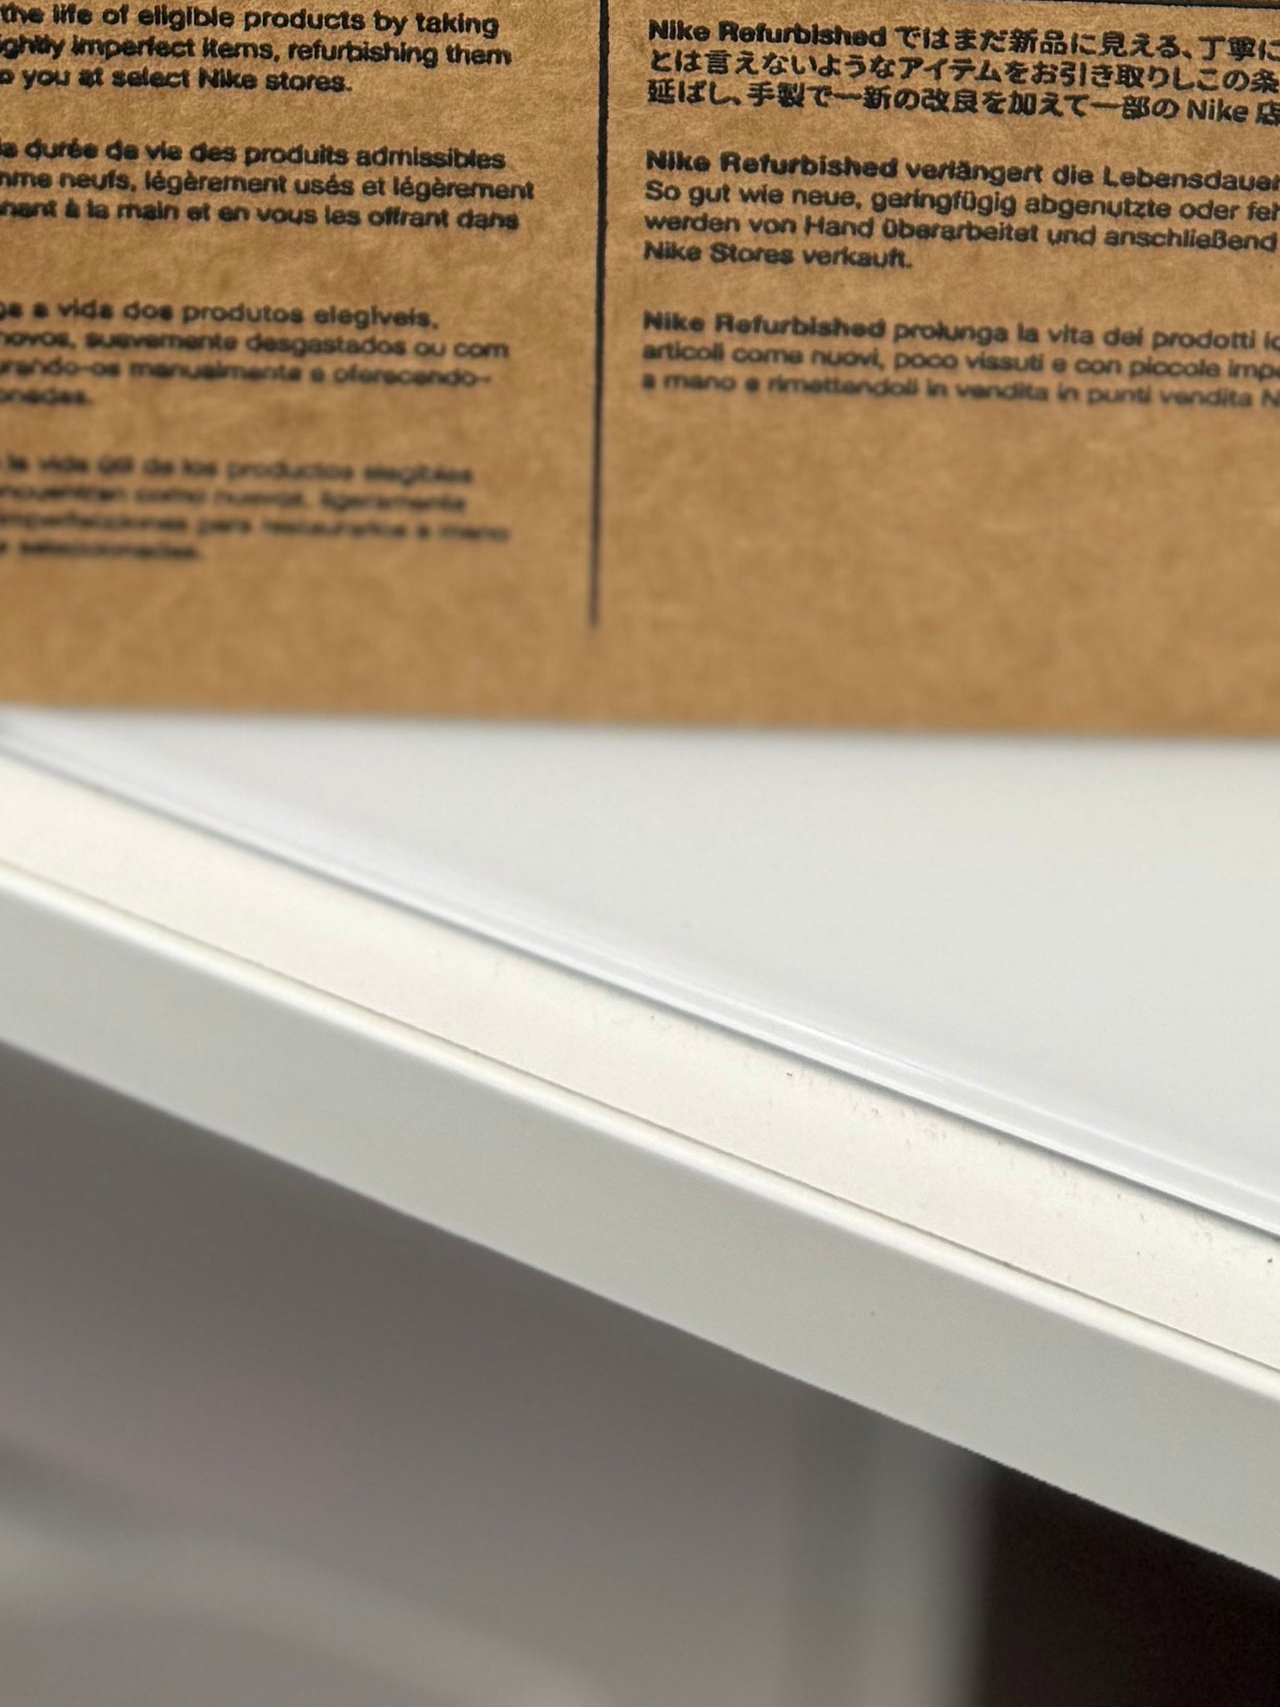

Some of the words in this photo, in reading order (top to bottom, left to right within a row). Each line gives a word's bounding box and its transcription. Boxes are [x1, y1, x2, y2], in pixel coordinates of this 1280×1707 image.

[0, 1, 46, 26] the
[52, 2, 94, 26] life
[101, 3, 130, 27] of
[137, 3, 236, 33] eligible
[243, 8, 367, 33] products
[372, 8, 409, 38] by
[414, 11, 501, 41] taking
[648, 18, 712, 43] Nike
[717, 19, 888, 49] Refurbished
[69, 34, 196, 64] imperfect
[201, 36, 281, 64] items,
[287, 38, 439, 70] refurbishing
[444, 42, 513, 67] them
[20, 68, 72, 92] you
[77, 66, 105, 90] at
[111, 66, 191, 90] select
[197, 66, 259, 91] Nike
[264, 70, 353, 94] stores.
[1186, 97, 1250, 124] Nike
[23, 137, 100, 162] durée
[104, 138, 140, 163] de
[144, 140, 183, 162] vie
[188, 141, 238, 165] des
[243, 143, 350, 168] produits
[355, 145, 507, 171] admissibles
[645, 149, 712, 174] Nike
[719, 150, 900, 180] Refurbished
[904, 159, 1044, 188] verlängert
[1051, 163, 1095, 187] die
[57, 168, 138, 194] neufs,
[144, 169, 288, 197] légèrement
[293, 172, 356, 198] usés
[361, 176, 387, 197] et
[392, 175, 535, 204] légèrement
[644, 178, 682, 203] So
[687, 182, 732, 210] gut
[738, 183, 785, 206] wie
[791, 188, 863, 211] neue,
[870, 187, 1018, 219] geringfügig
[1024, 193, 1173, 222] abgenutzte
[1178, 198, 1241, 222] oder
[63, 197, 81, 220] à
[85, 198, 111, 221] la
[116, 200, 181, 226] main
[185, 202, 212, 223] et
[216, 205, 251, 224] en
[255, 207, 319, 227] vous
[324, 204, 363, 228] les
[366, 205, 450, 230] offrant
[455, 208, 521, 234] dans
[643, 211, 742, 235] werden
[747, 217, 798, 236] von
[803, 214, 876, 240] Hand
[881, 217, 1040, 244] überarbeitet
[1046, 224, 1097, 248] und
[1103, 227, 1279, 254] anschließend
[642, 240, 703, 264] Nike
[708, 241, 796, 267] Stores
[801, 245, 914, 271] verkauft.
[642, 309, 706, 334] Nike
[714, 312, 887, 340] Refurbished
[892, 319, 1010, 348] prolunga
[1016, 321, 1041, 345] la
[1047, 323, 1096, 347] vita
[1102, 326, 1145, 349] dei
[1151, 329, 1257, 352] prodotti
